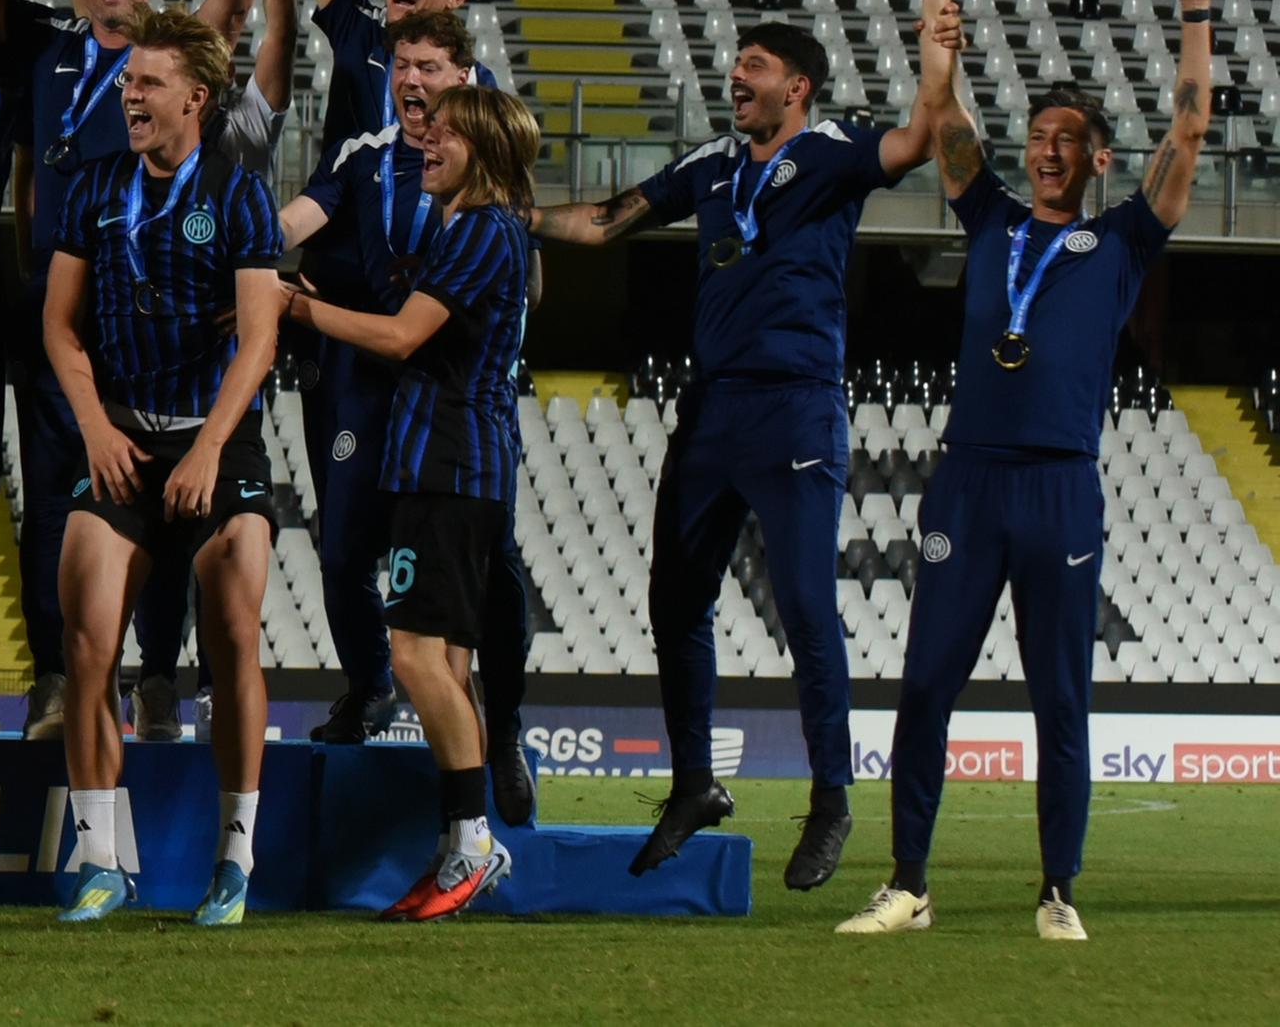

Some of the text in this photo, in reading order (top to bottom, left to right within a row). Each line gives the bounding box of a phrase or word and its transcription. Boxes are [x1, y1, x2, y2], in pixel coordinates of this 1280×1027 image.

[389, 547, 417, 594] 6
[525, 727, 604, 762] SGS
[853, 741, 893, 780] ky
[1102, 745, 1167, 782] sky
[1181, 751, 1280, 782] sport
